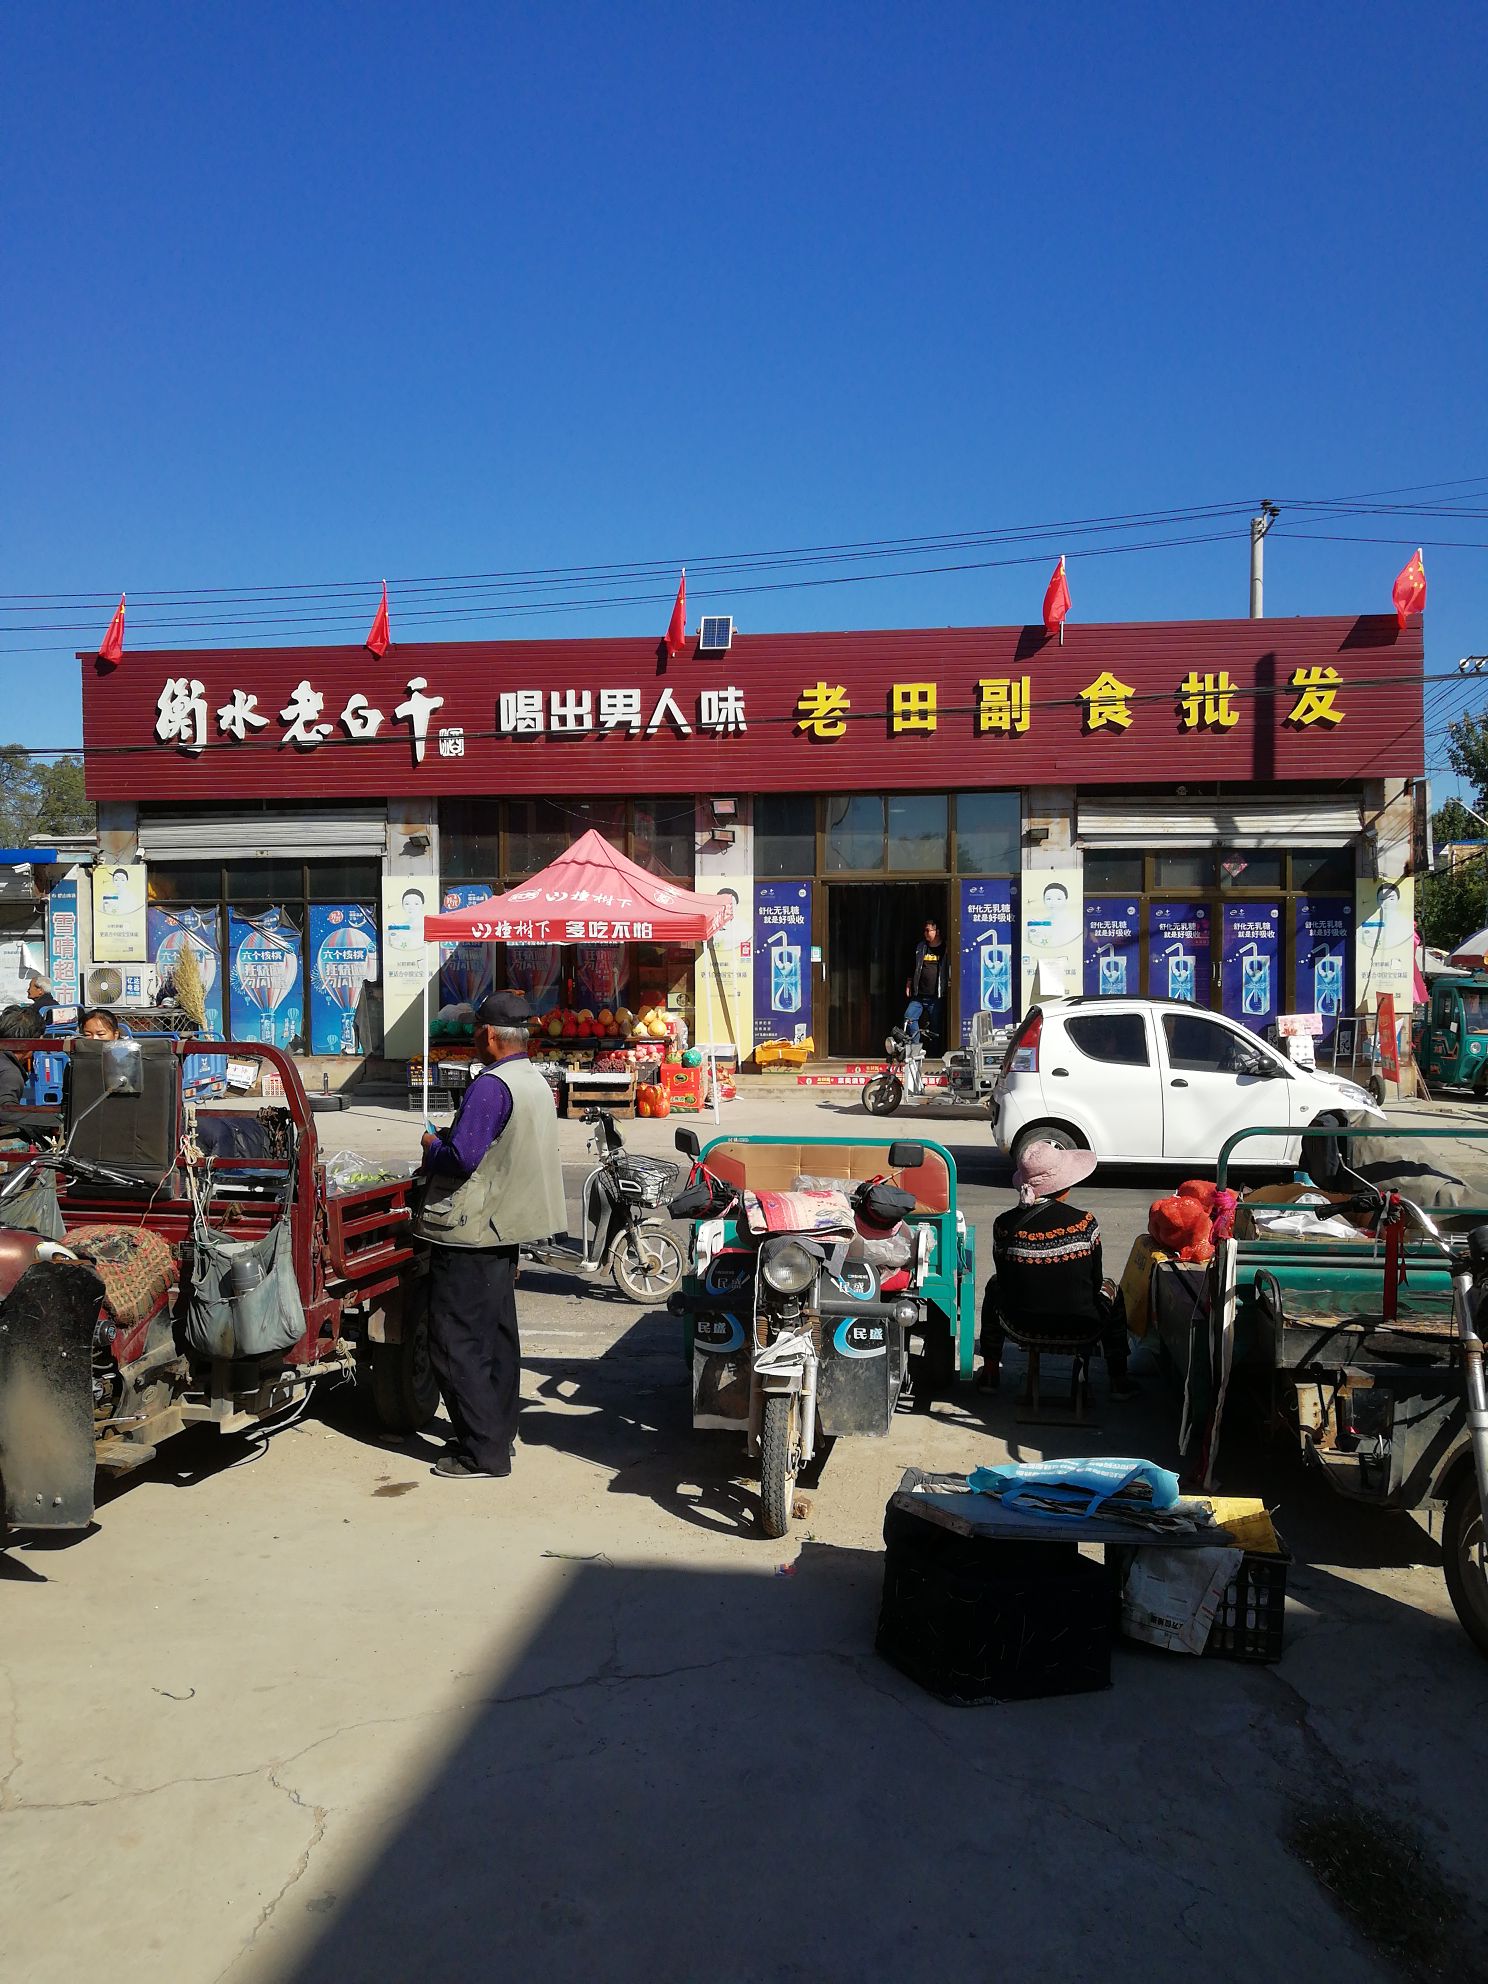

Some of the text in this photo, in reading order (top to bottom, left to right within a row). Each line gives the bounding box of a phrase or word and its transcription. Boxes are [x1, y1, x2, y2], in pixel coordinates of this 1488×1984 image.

[499, 686, 747, 734] 喝出男人味
[797, 667, 1346, 737] 老田副食批发
[155, 676, 444, 763] 衡水老白干
[471, 920, 551, 939] 山楂树下
[565, 921, 653, 939] 多吃不怕
[53, 911, 76, 1005] 雪晴超市
[241, 951, 283, 960] 六个核桃
[322, 950, 365, 960] 六个核桃
[697, 1321, 726, 1334] 民盛
[853, 1327, 884, 1340] 民盛
